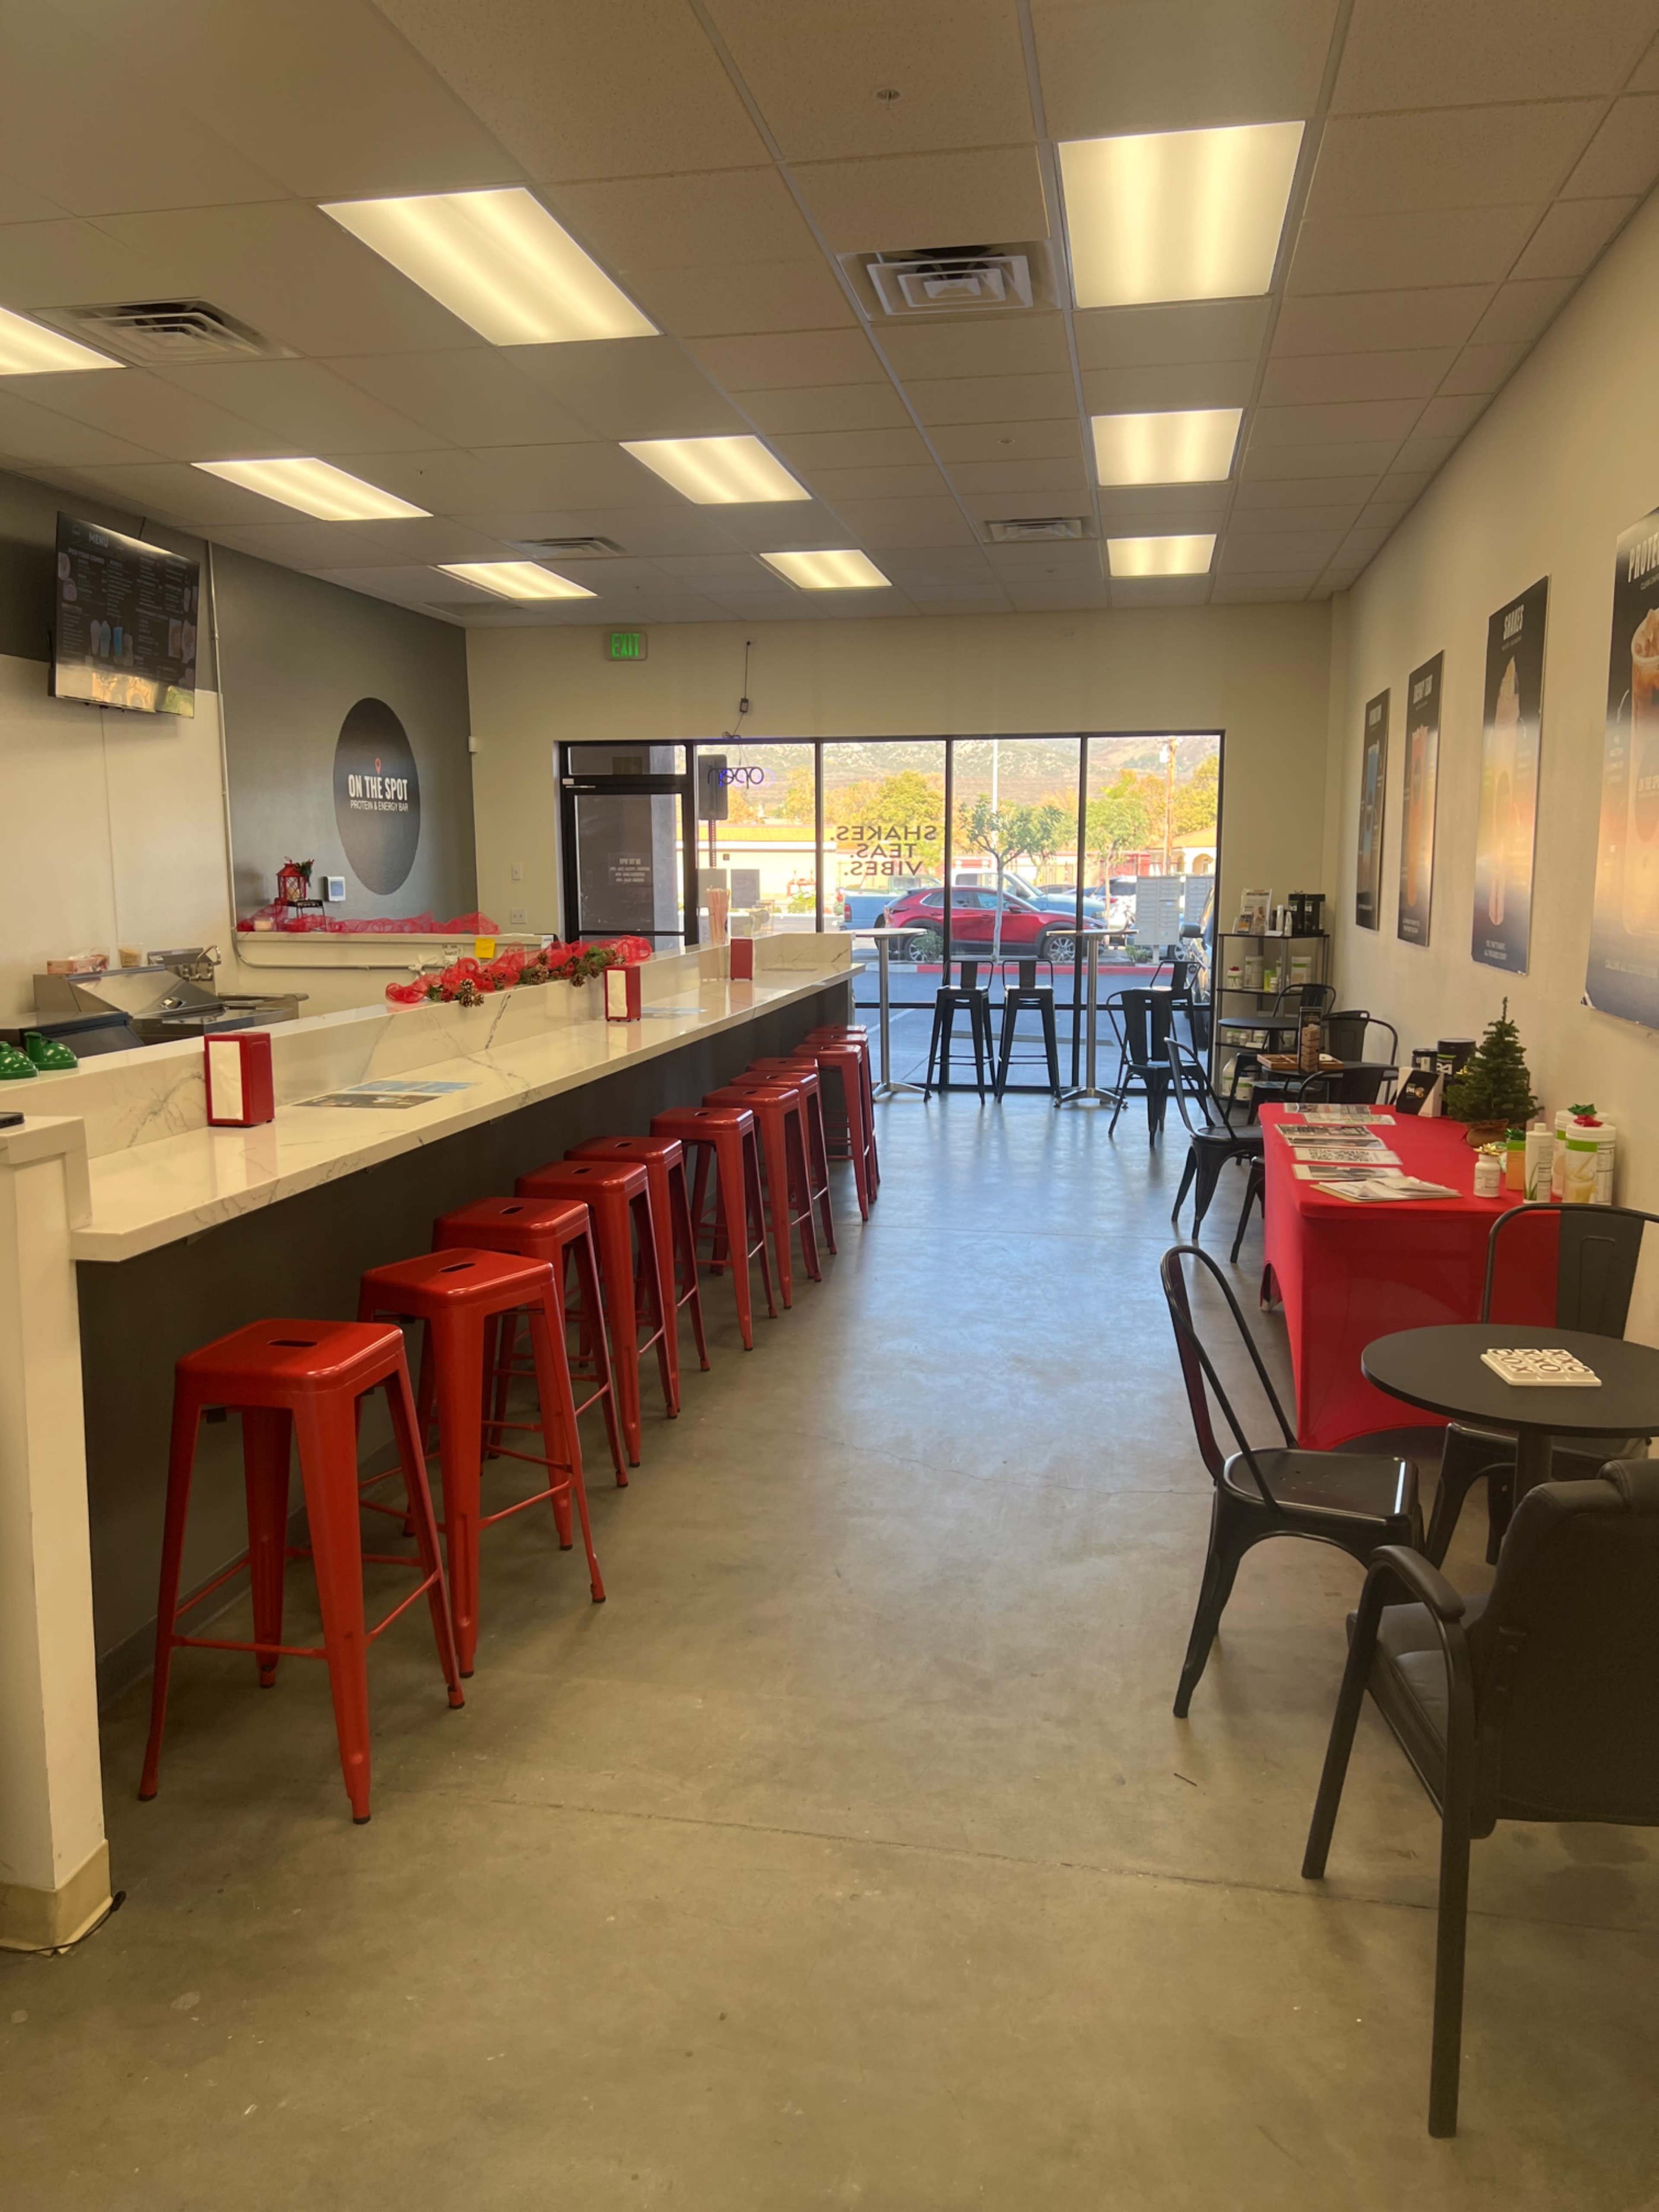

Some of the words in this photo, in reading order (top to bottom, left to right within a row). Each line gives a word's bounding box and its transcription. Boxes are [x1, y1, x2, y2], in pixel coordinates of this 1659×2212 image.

[611, 633, 640, 657] EXIT
[348, 774, 362, 798] ON
[364, 775, 383, 798] THE
[385, 777, 407, 801] SPOT
[350, 800, 373, 810] PROTEIN
[374, 801, 378, 810] &
[378, 801, 397, 811] ENERGY
[398, 802, 409, 812] BAR
